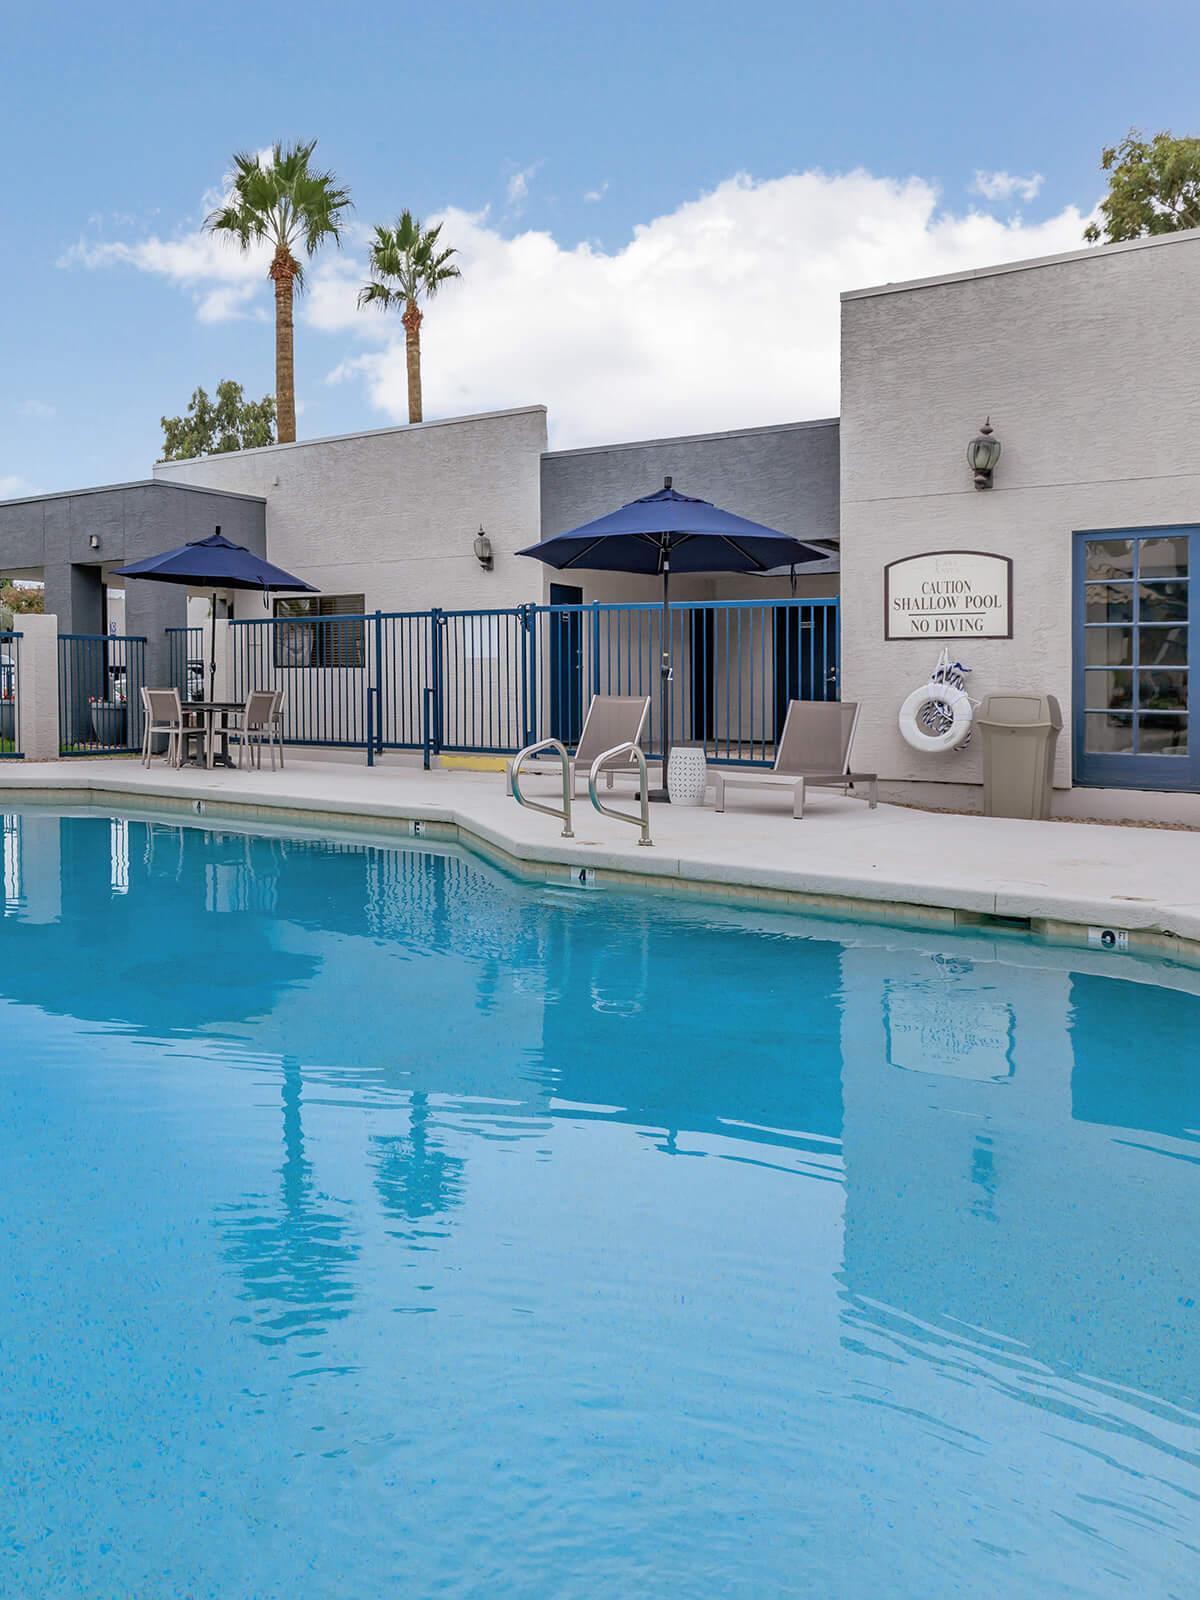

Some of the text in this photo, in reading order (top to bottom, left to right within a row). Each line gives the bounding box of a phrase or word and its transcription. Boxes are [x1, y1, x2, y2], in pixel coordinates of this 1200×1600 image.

[921, 580, 971, 594] CAUTION
[894, 595, 1002, 611] SHALLOW POOL
[911, 618, 984, 633] NO DIVING
